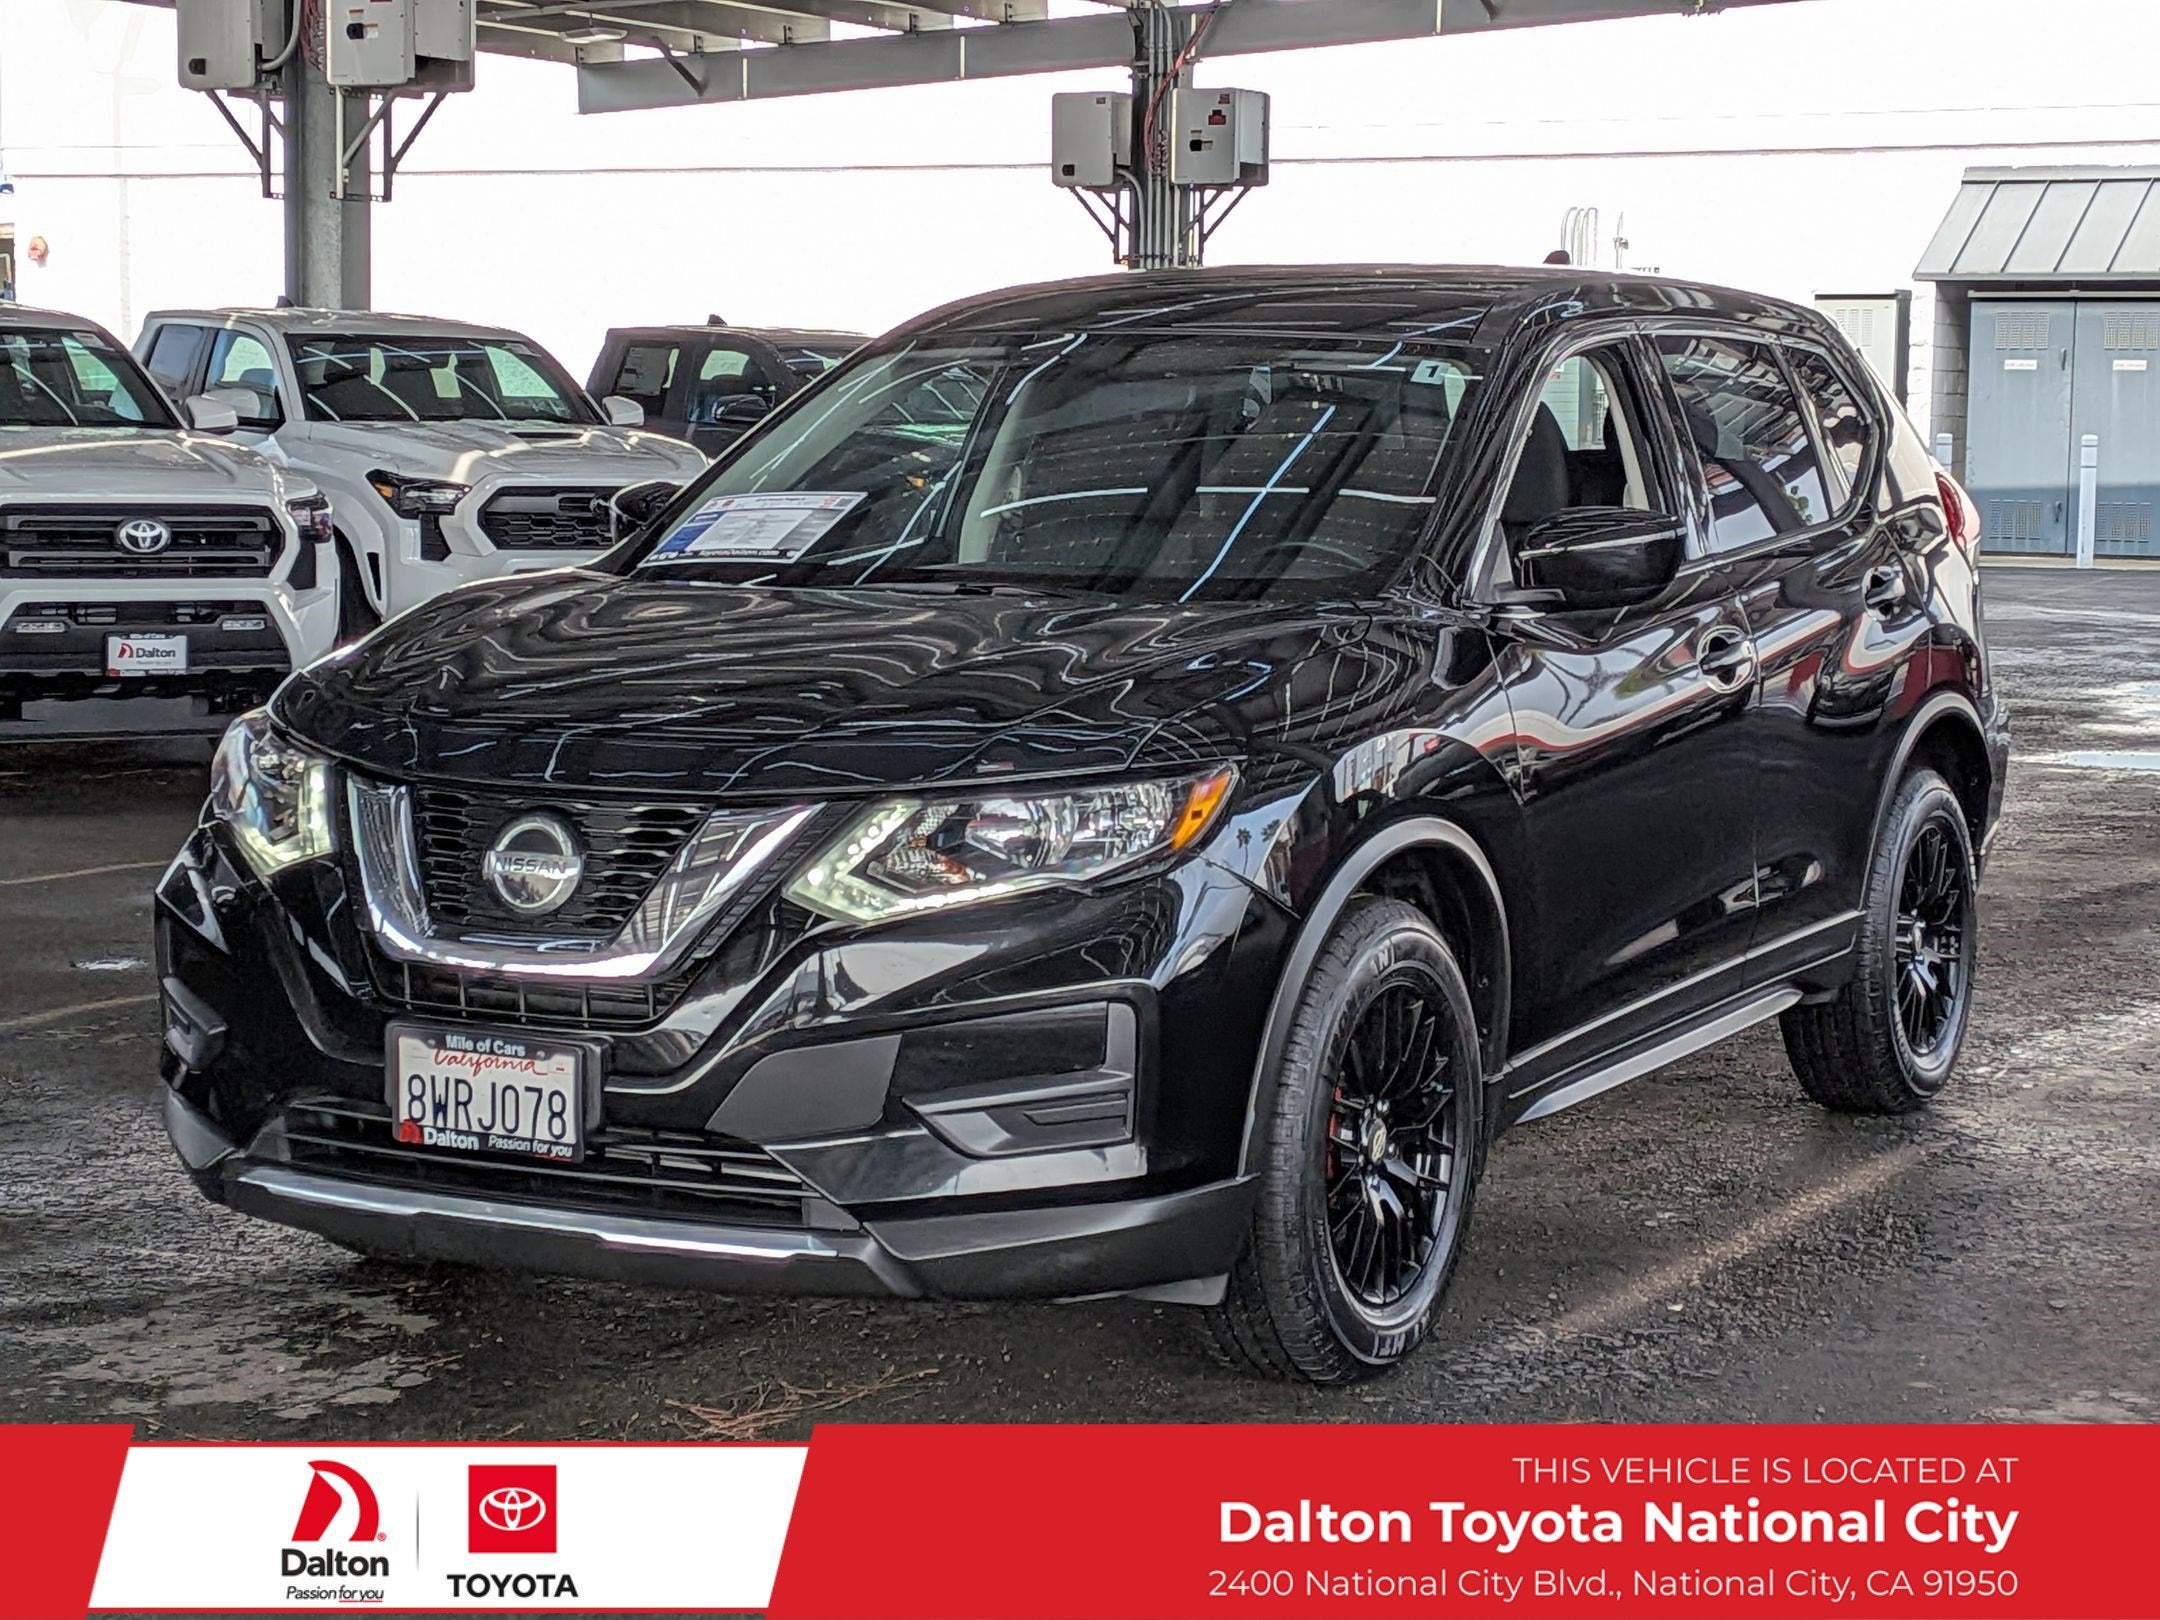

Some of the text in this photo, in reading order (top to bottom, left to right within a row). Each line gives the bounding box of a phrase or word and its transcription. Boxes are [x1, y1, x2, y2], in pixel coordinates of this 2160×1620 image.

[135, 647, 176, 659] Dalton
[496, 856, 567, 875] NISSAN
[445, 1034, 526, 1057] Mile of Cars
[407, 1073, 567, 1140] 8WRJ078
[423, 1126, 574, 1158] Dalton Passion for you
